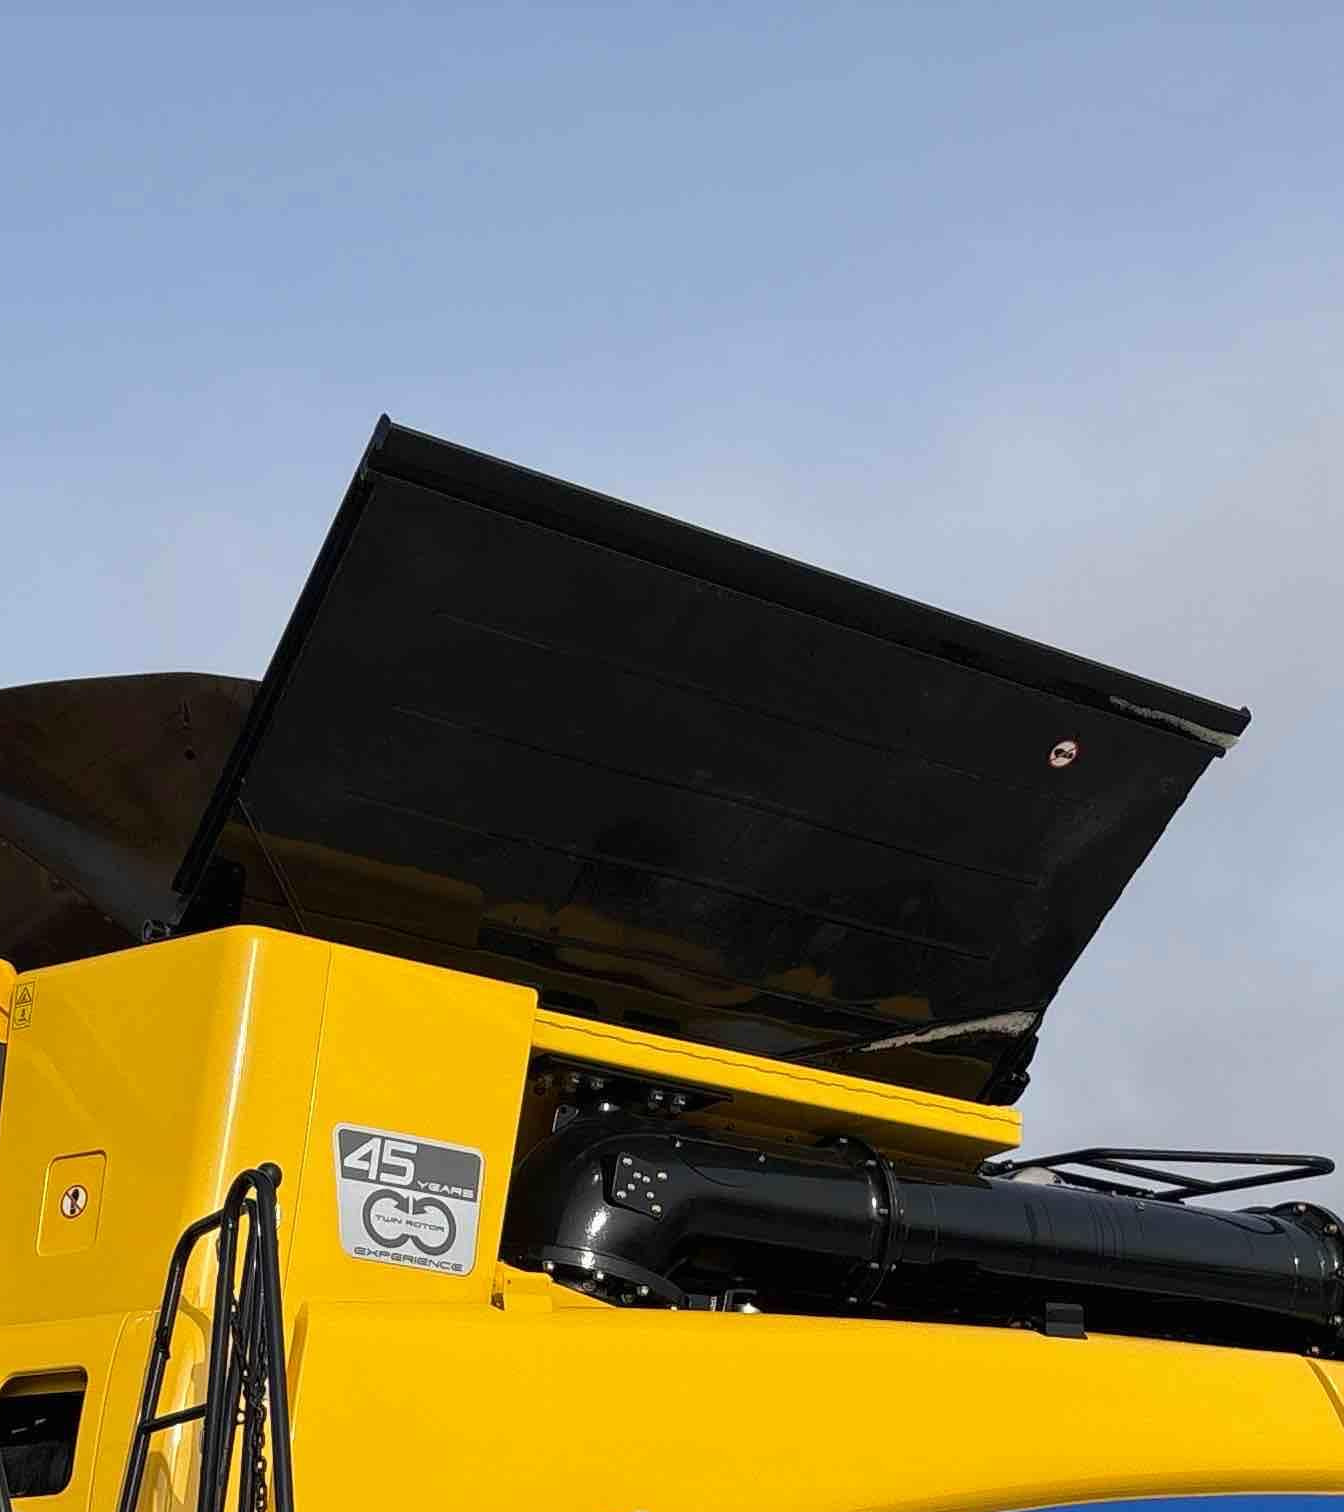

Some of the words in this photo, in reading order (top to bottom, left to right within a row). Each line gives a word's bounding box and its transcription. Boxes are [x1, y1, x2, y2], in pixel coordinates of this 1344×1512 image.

[343, 1137, 418, 1186] 45
[416, 1180, 475, 1199] YEARS
[375, 1213, 403, 1225] TWIN
[405, 1220, 446, 1233] ROTOR
[353, 1246, 464, 1272] EXPERIENCE
